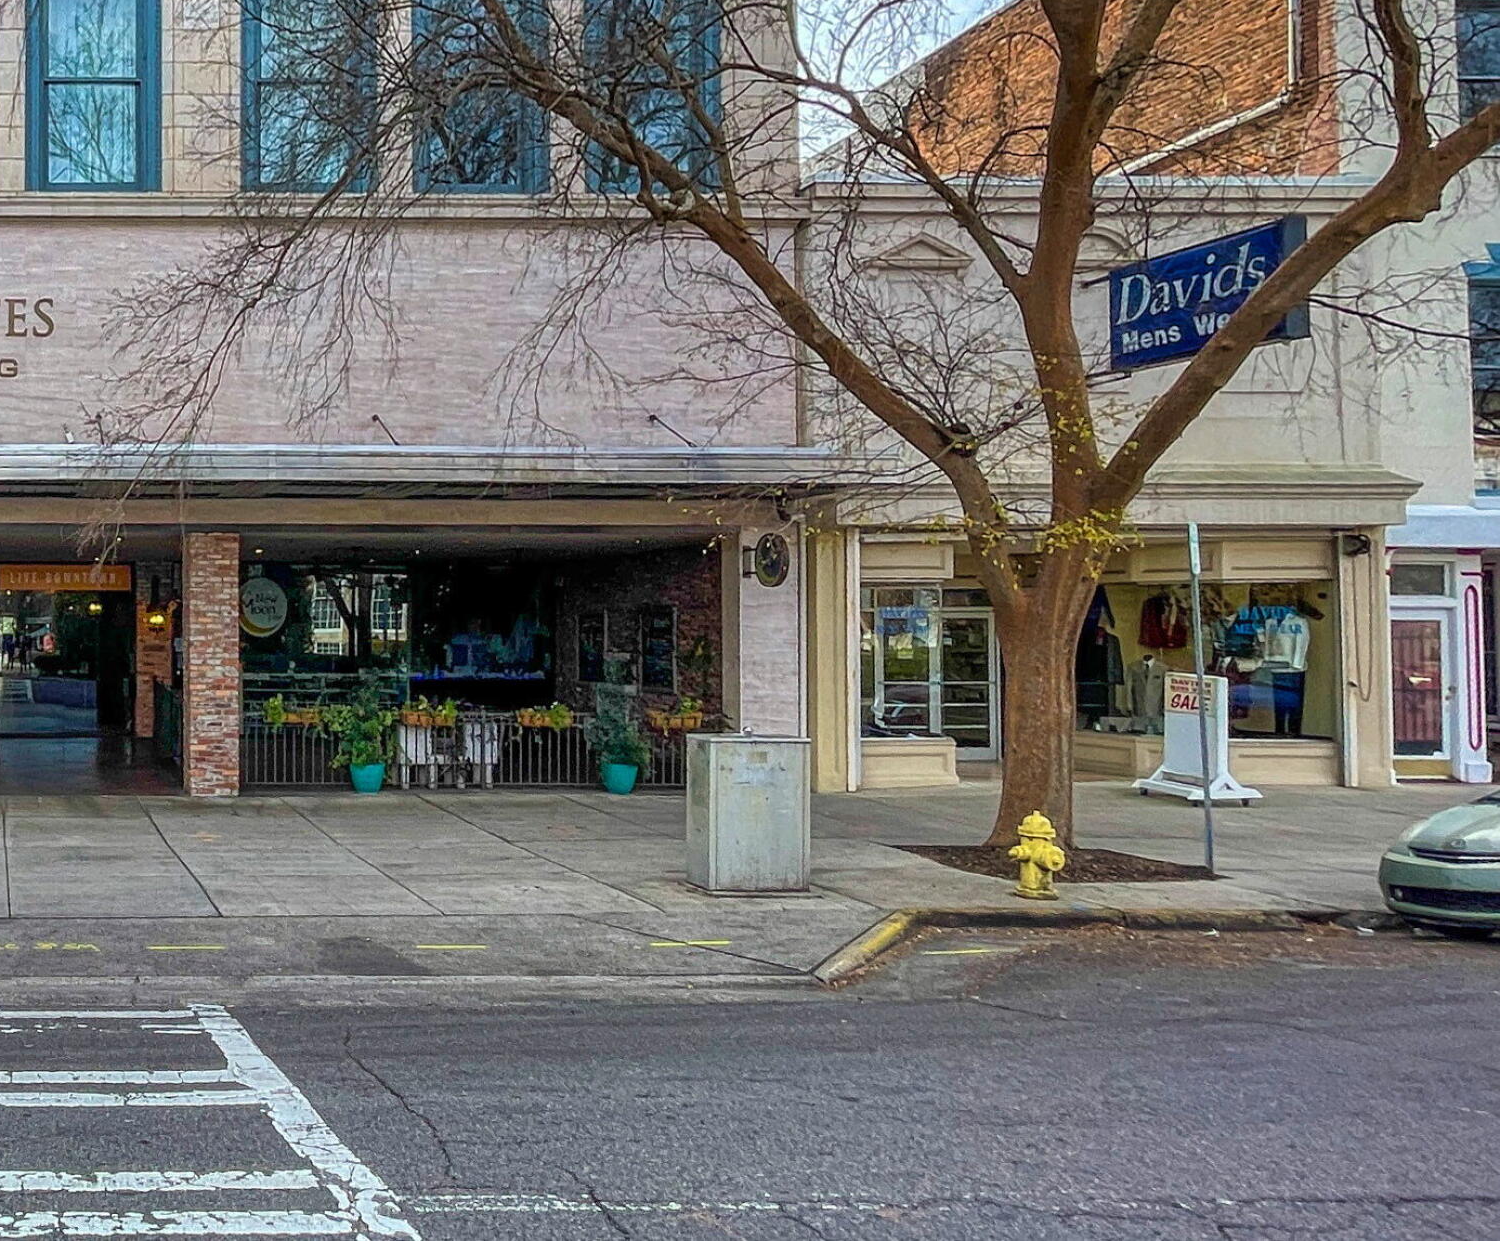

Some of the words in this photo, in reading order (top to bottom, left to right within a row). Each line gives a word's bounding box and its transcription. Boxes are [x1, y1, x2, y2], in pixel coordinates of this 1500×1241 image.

[1115, 242, 1266, 326] Davids
[1122, 325, 1182, 354] Mens
[1192, 312, 1231, 337] We
